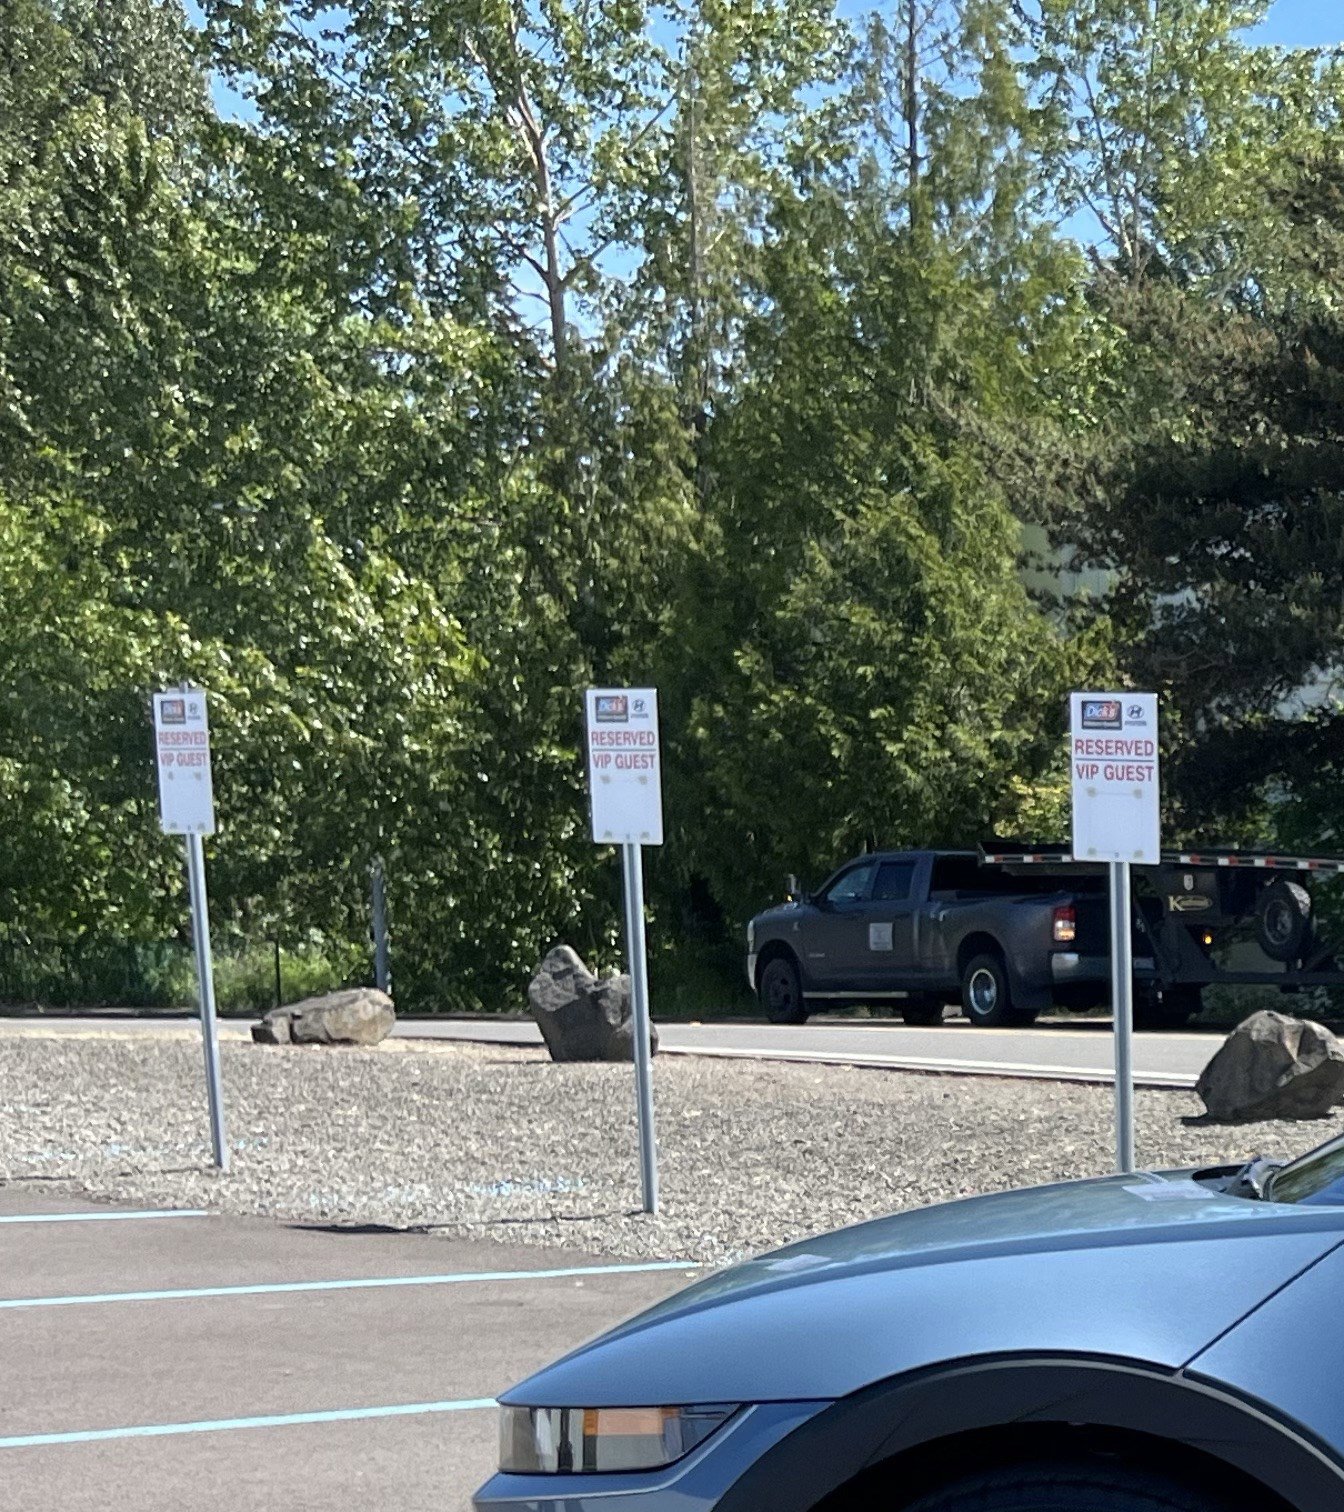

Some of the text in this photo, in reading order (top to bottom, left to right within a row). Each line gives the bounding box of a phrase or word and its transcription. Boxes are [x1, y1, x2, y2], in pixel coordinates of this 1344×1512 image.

[158, 731, 207, 746] RESERVED
[591, 731, 656, 746] RESERVED
[1075, 738, 1155, 757] RESERVED
[160, 752, 207, 767] VIP GUEST
[593, 753, 656, 770] VIP GUEST
[1076, 764, 1155, 782] VIP GUEST
